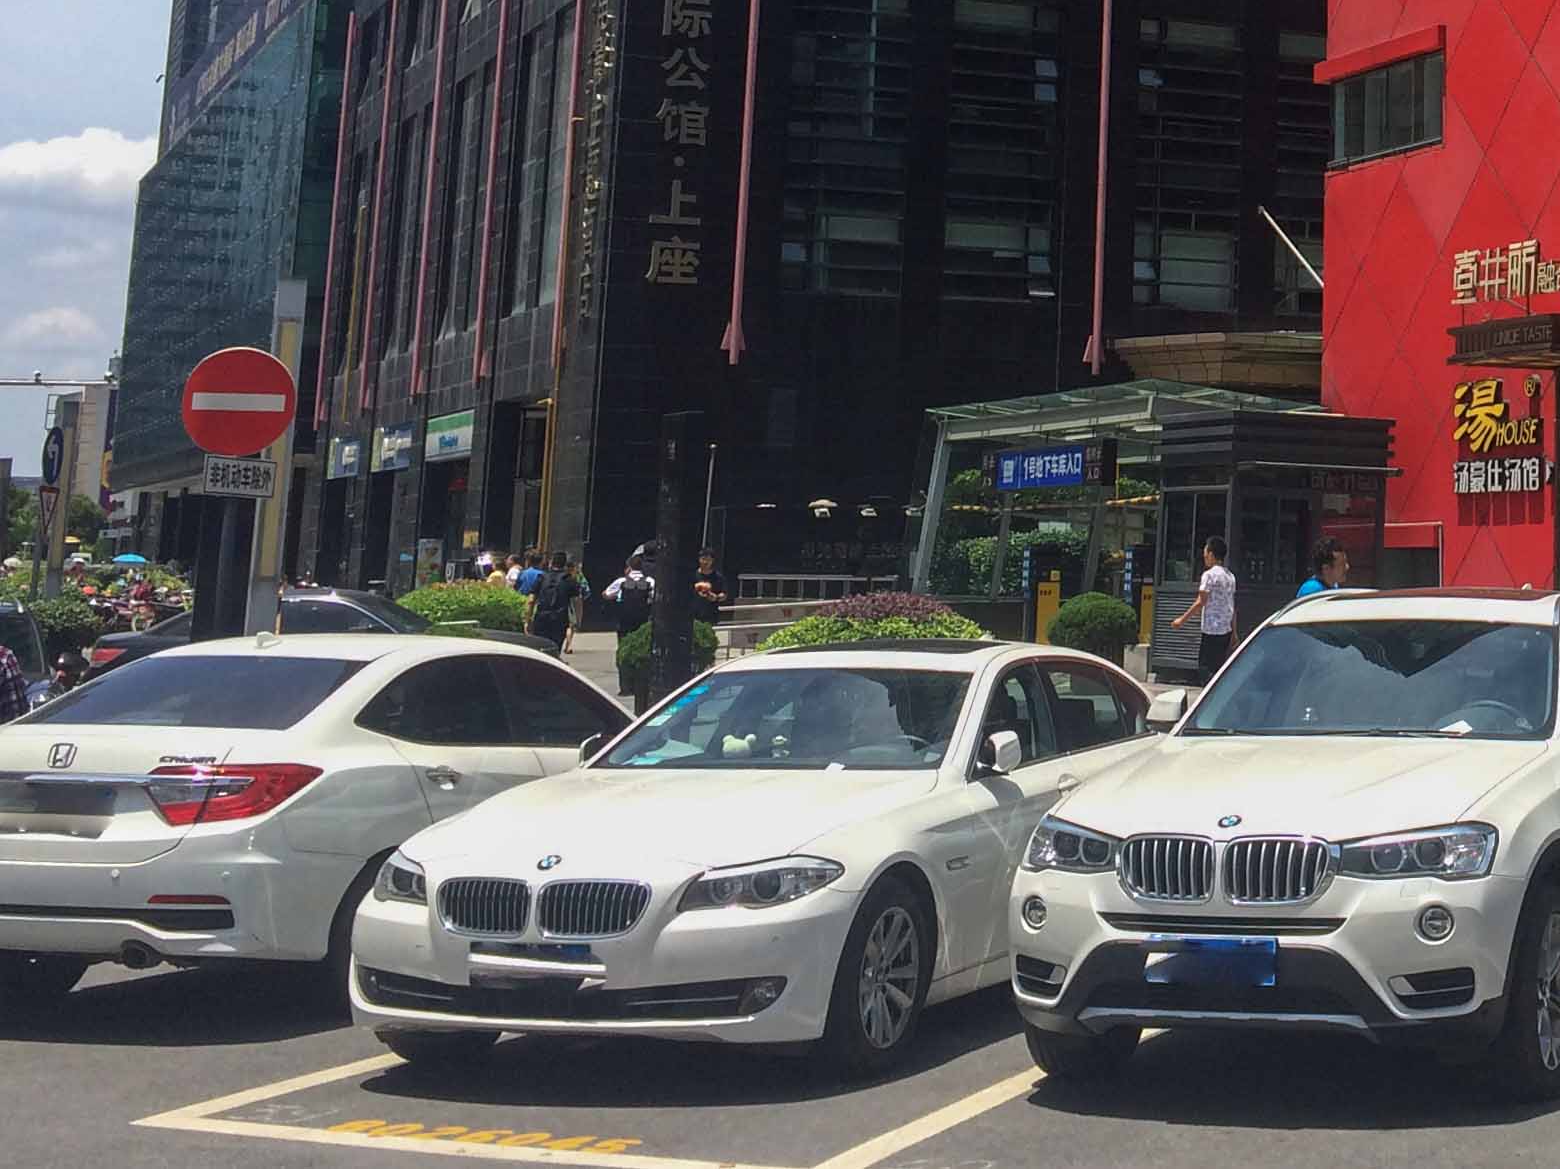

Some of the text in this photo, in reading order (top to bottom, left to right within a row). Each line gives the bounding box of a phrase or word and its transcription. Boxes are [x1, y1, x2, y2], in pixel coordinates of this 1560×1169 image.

[1496, 418, 1539, 447] HOUSE
[209, 462, 272, 493] 非机动车除外
[1453, 457, 1540, 494] 汤豪仕汤馆
